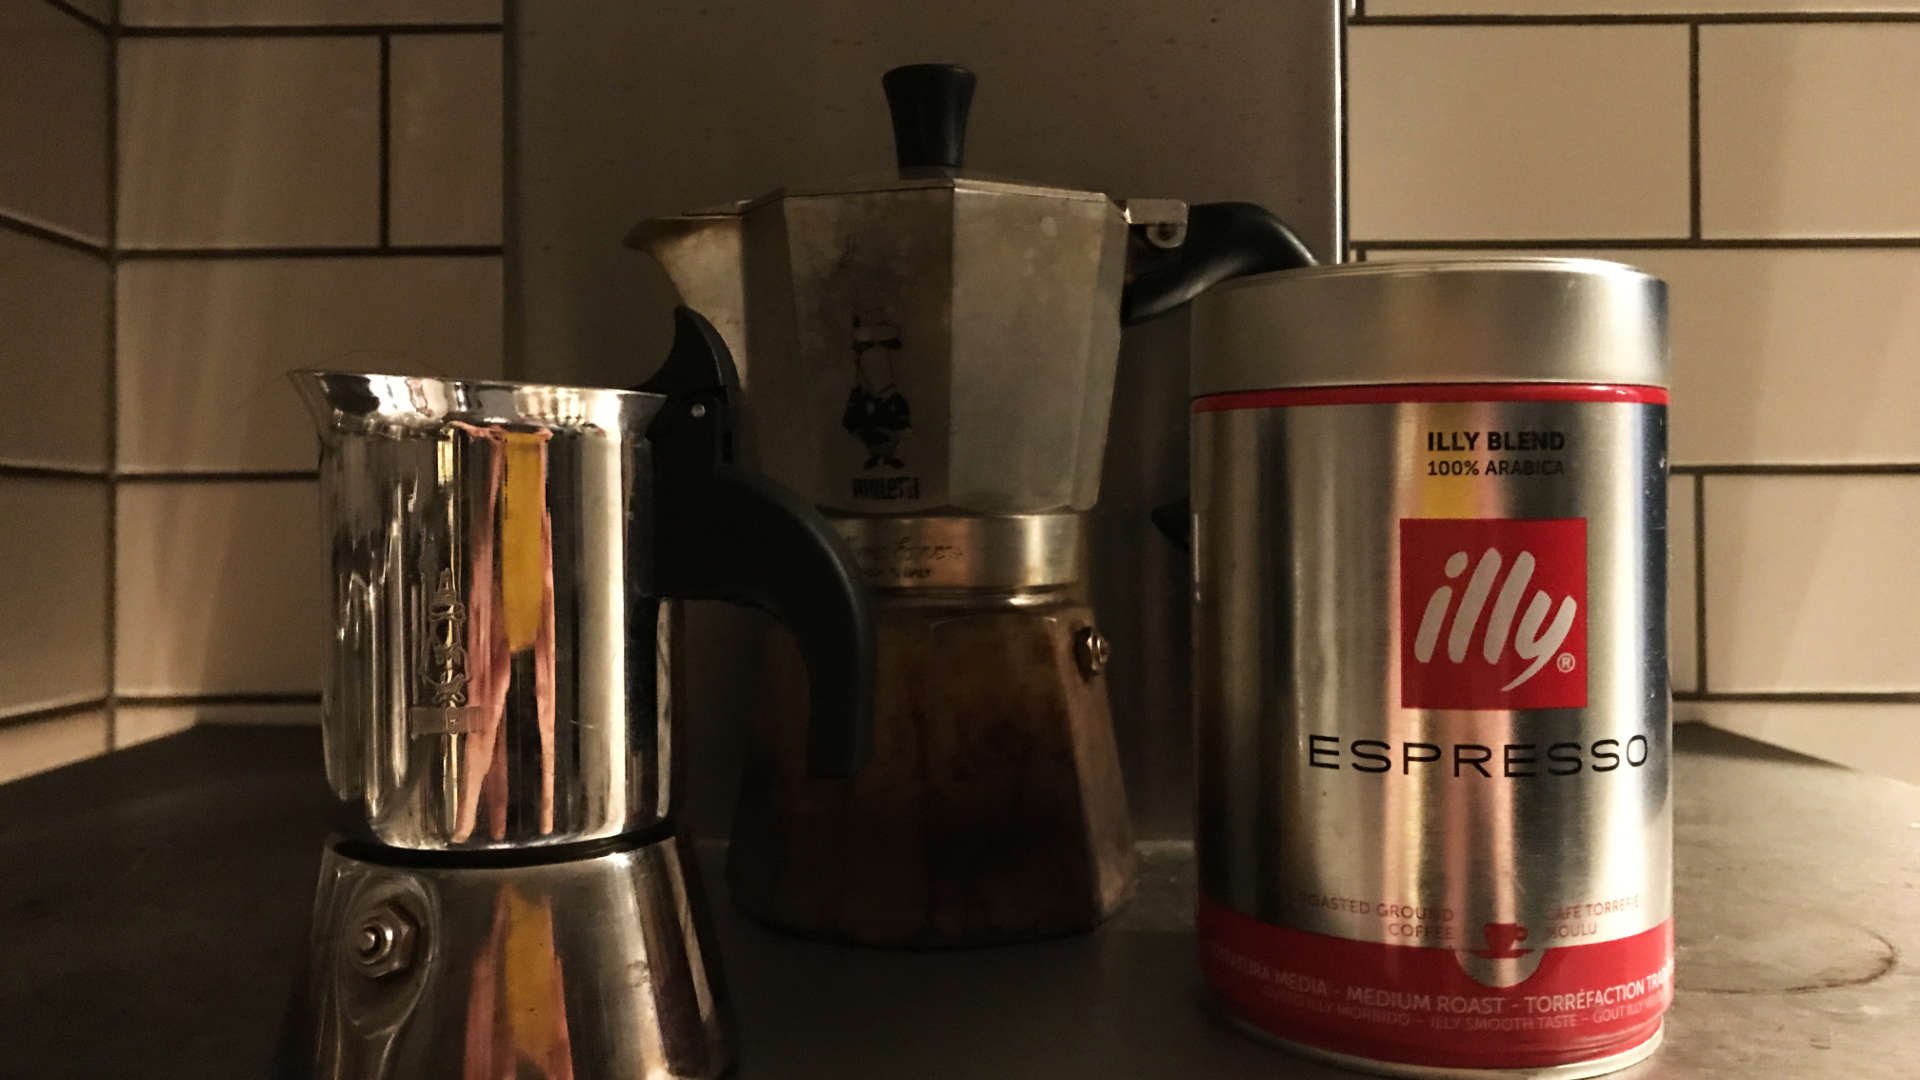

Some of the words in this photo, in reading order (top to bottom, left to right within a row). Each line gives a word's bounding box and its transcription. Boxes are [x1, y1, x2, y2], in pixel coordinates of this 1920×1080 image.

[1427, 431, 1479, 451] ILLY
[1487, 431, 1565, 451] BLEND
[1427, 460, 1480, 476] 100%
[1485, 460, 1564, 476] ARABICA
[1414, 547, 1577, 692] illy
[1309, 734, 1649, 778] ESPRESSO
[1376, 903, 1454, 922] GROUND
[1274, 969, 1328, 996] MEDIA
[1346, 985, 1431, 1012] MEDIUM
[1436, 996, 1505, 1014] ROAST
[1524, 979, 1645, 1014] TORRÉFACTION
[1465, 1015, 1534, 1031] SMOOTH
[1536, 1014, 1577, 1029] TASTE
